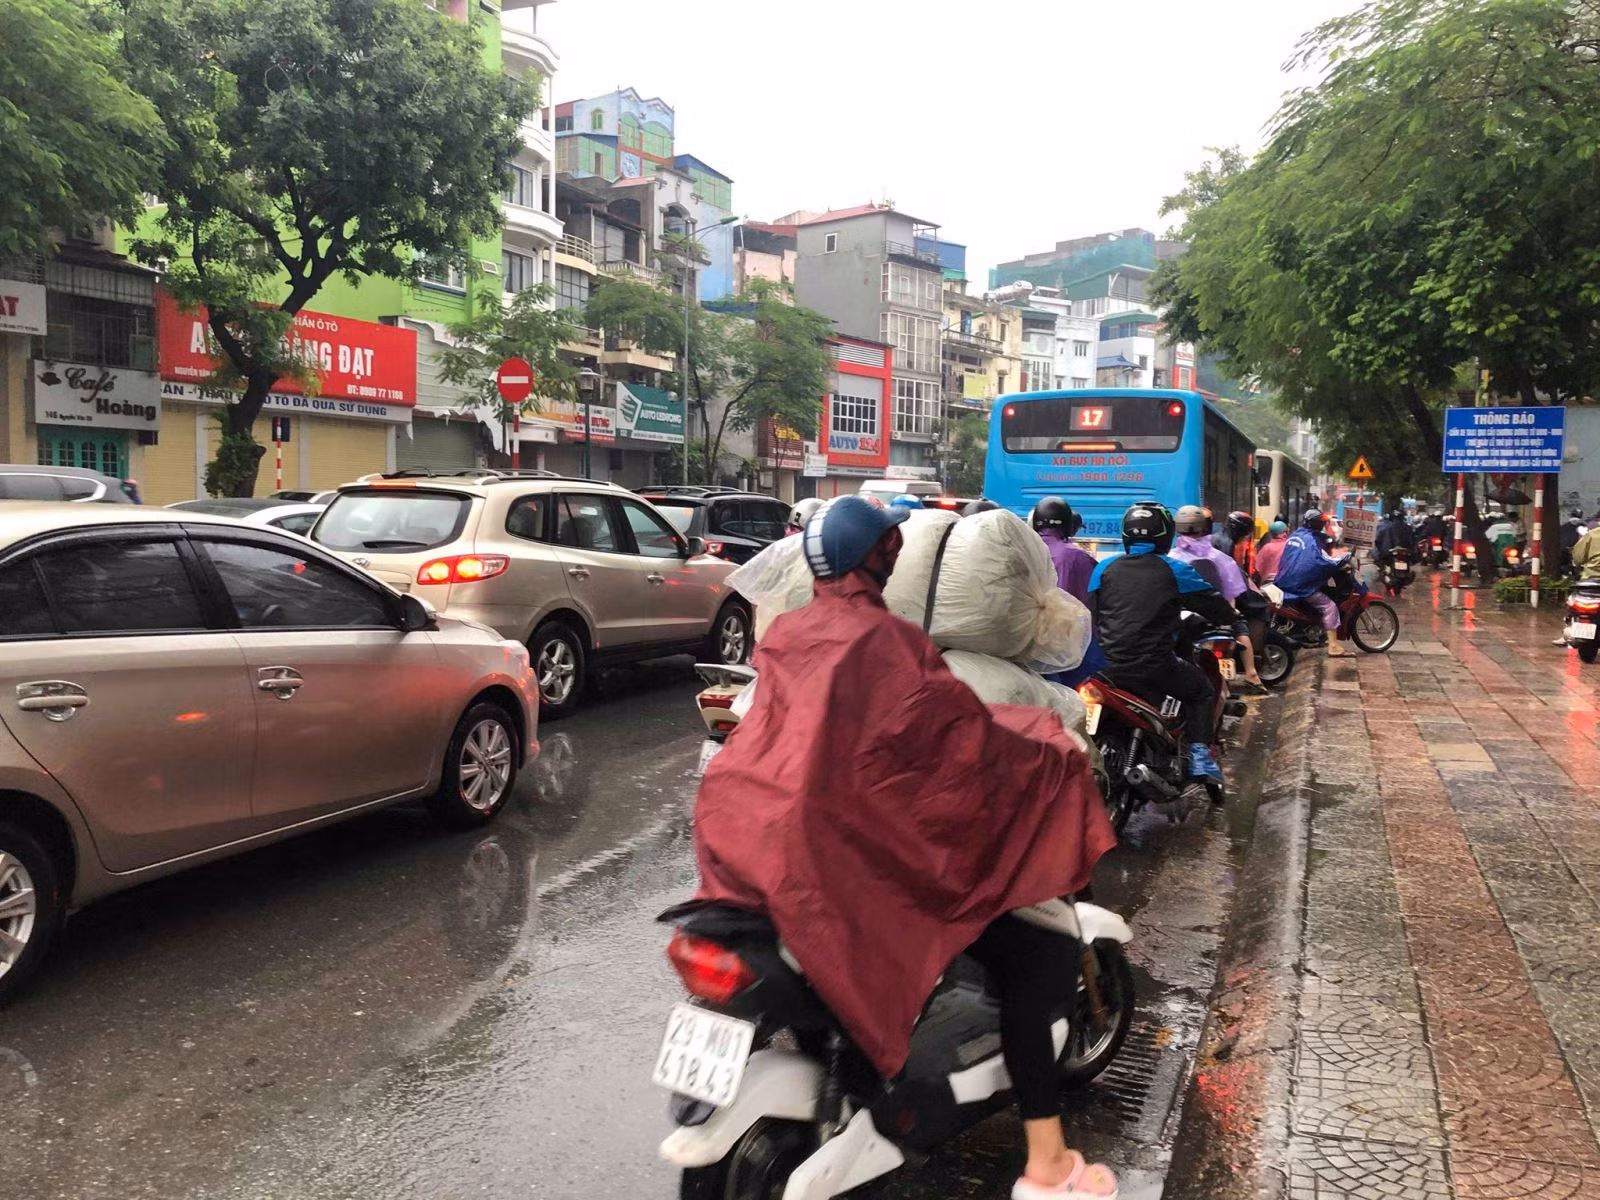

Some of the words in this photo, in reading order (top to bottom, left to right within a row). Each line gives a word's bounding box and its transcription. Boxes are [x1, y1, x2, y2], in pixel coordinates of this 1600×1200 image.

[338, 344, 375, 380] ĐẠT
[65, 367, 118, 403] Café
[96, 398, 157, 422] Hoàng
[312, 398, 336, 410] QUA
[357, 404, 387, 416] DỤNG
[1081, 409, 1104, 427] 17
[1473, 411, 1510, 425] THÔNG
[1512, 411, 1536, 425] BÁO
[829, 435, 858, 450] AUTO
[859, 437, 881, 453] 124
